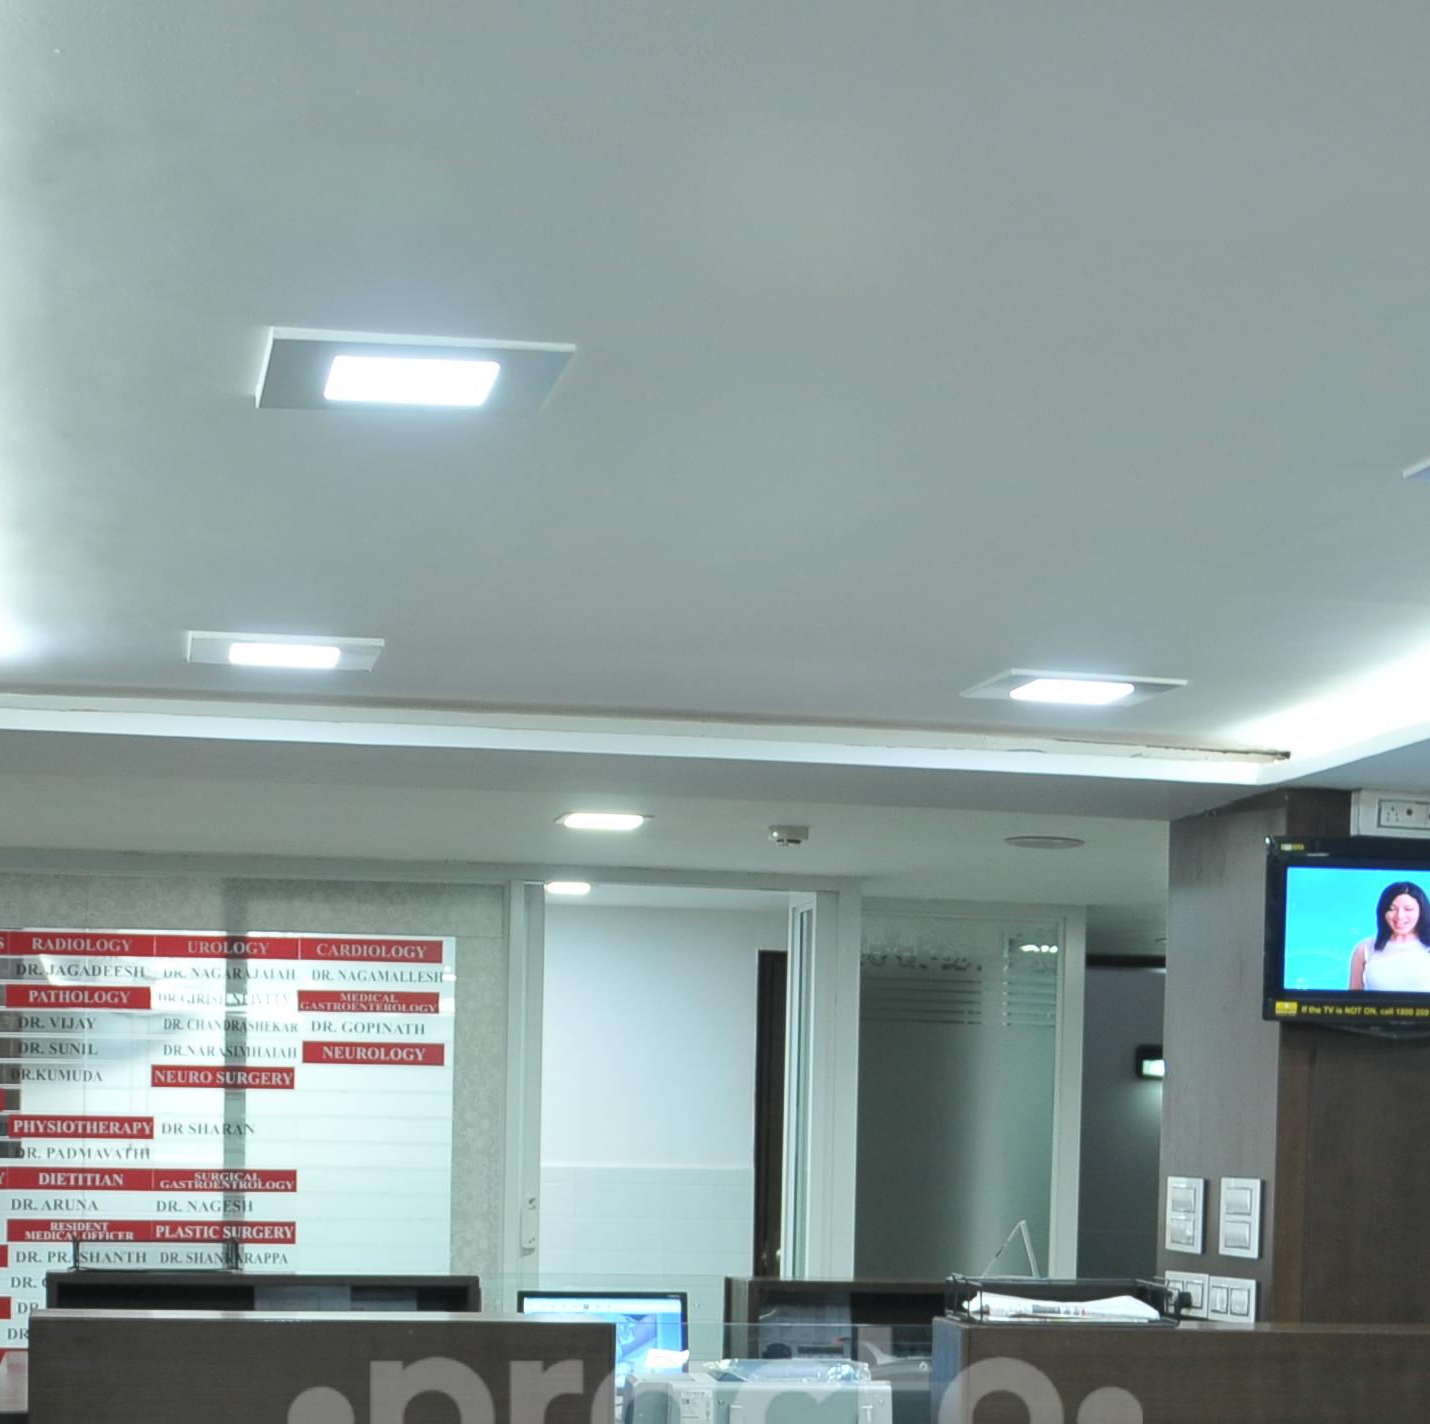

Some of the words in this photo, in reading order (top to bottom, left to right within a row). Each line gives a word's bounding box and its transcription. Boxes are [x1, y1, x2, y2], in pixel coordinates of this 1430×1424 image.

[31, 937, 133, 952] RADIOLOGY
[188, 940, 270, 955] UROLOGY
[316, 943, 428, 959] CARDIOLOGY
[15, 964, 43, 977] DR.
[46, 964, 145, 978] JAGADEESH
[191, 967, 296, 981] NAGARAJAIAH
[311, 969, 335, 982] DR.
[338, 969, 444, 984] NAGAMALLESH
[28, 990, 131, 1004] PATHOLOGY
[340, 992, 399, 1003] MEDICAL
[300, 1001, 438, 1013] GASTROENTEROLOGY
[1309, 1005, 1321, 1014] the
[1323, 1006, 1334, 1014] TV
[1345, 1007, 1362, 1015] NOT
[1380, 1008, 1394, 1016] call
[18, 1016, 45, 1030] DR.
[49, 1016, 97, 1030] VIJAY
[163, 1018, 185, 1031] DR.
[186, 1018, 299, 1033] CHANDRASHEKAR
[311, 1020, 337, 1033] DR.
[341, 1020, 426, 1035] GOPINATH
[18, 1041, 45, 1055] DR.
[49, 1042, 99, 1056] SUNIL
[322, 1046, 426, 1061] NEUROLOGY
[11, 1067, 103, 1082] DR.KUMUDA
[154, 1069, 213, 1084] NEURO
[216, 1071, 294, 1086] SURGERY
[13, 1120, 154, 1135] PHYSIOTHERAPY
[187, 1123, 255, 1136] SHARAN
[14, 1146, 40, 1159] DR.
[46, 1146, 151, 1160] PADMAVATHI
[38, 1172, 124, 1186] DIETITIAN
[193, 1172, 261, 1181] SURGICAL
[159, 1179, 295, 1190] GASTROENTROLOGY
[10, 1199, 38, 1212] DR.
[43, 1199, 99, 1212] ARUNA
[156, 1200, 183, 1212] DR.
[186, 1200, 253, 1213] NAGESH
[50, 1221, 110, 1231] RESIDENT
[155, 1225, 218, 1239] PLASTIC
[222, 1226, 295, 1240] SURGERY
[25, 1231, 81, 1241] MEDICAL
[82, 1231, 135, 1241] OFFICER
[16, 1250, 42, 1263] DR.
[160, 1251, 182, 1264] DR.
[10, 1276, 37, 1289] DR.
